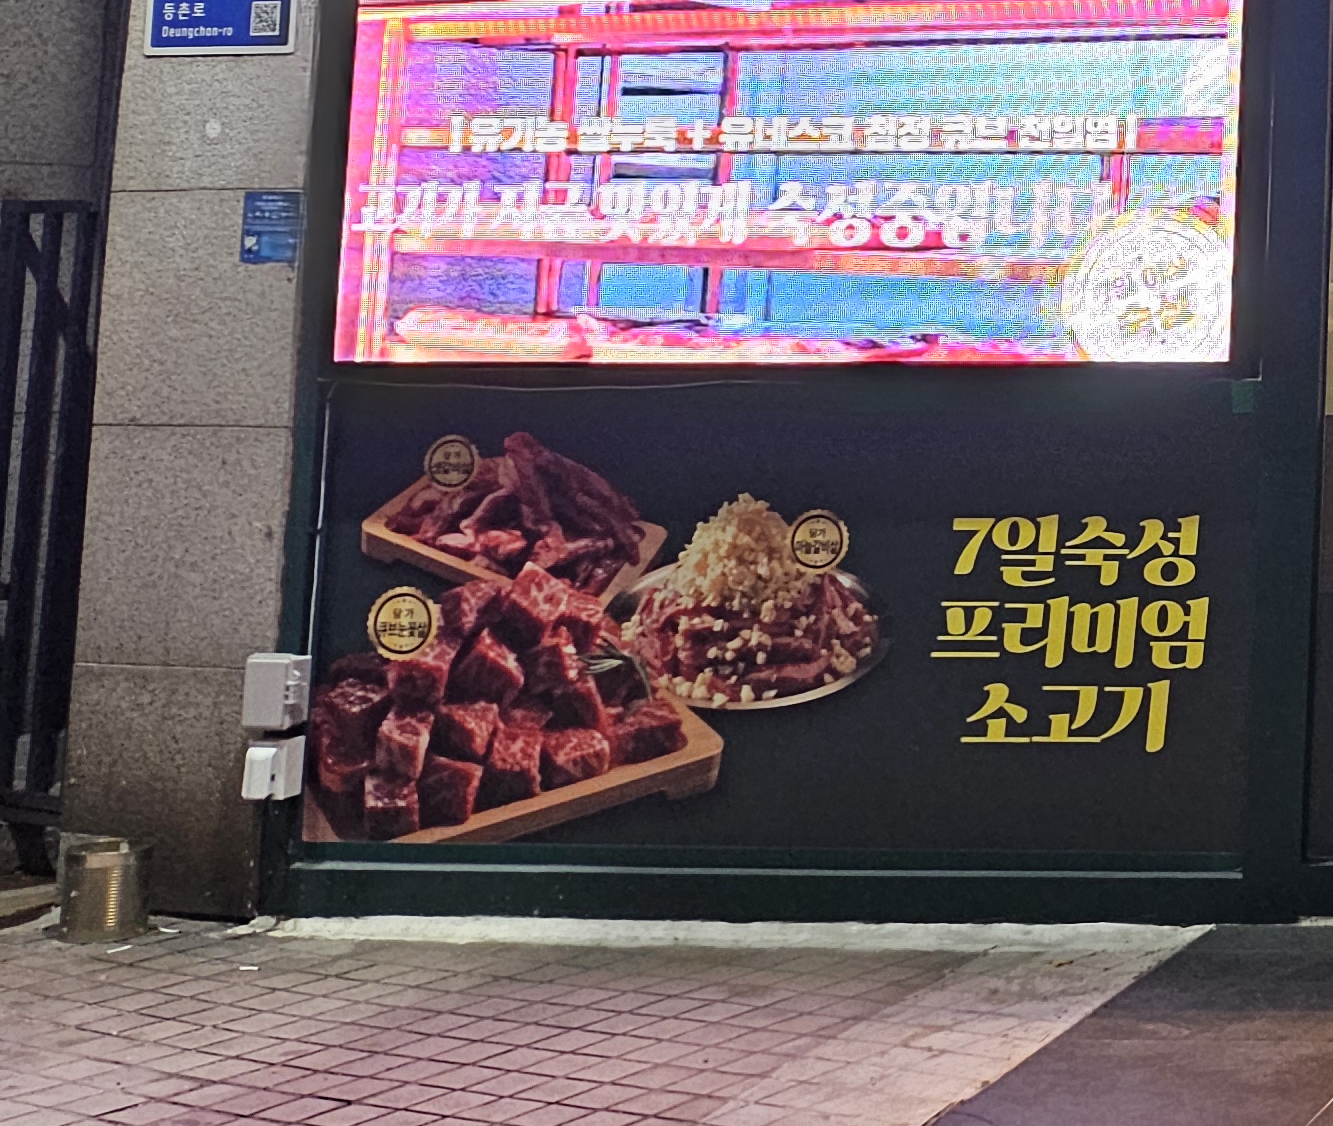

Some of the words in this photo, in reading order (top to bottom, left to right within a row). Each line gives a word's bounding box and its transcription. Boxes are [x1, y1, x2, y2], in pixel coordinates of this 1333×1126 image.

[161, 2, 207, 22] 등촌로
[161, 24, 234, 39] Deungchon-ro
[949, 512, 1203, 590] 7일숙성
[930, 596, 1211, 671] 프리미엄
[958, 678, 1173, 754] 소고기
